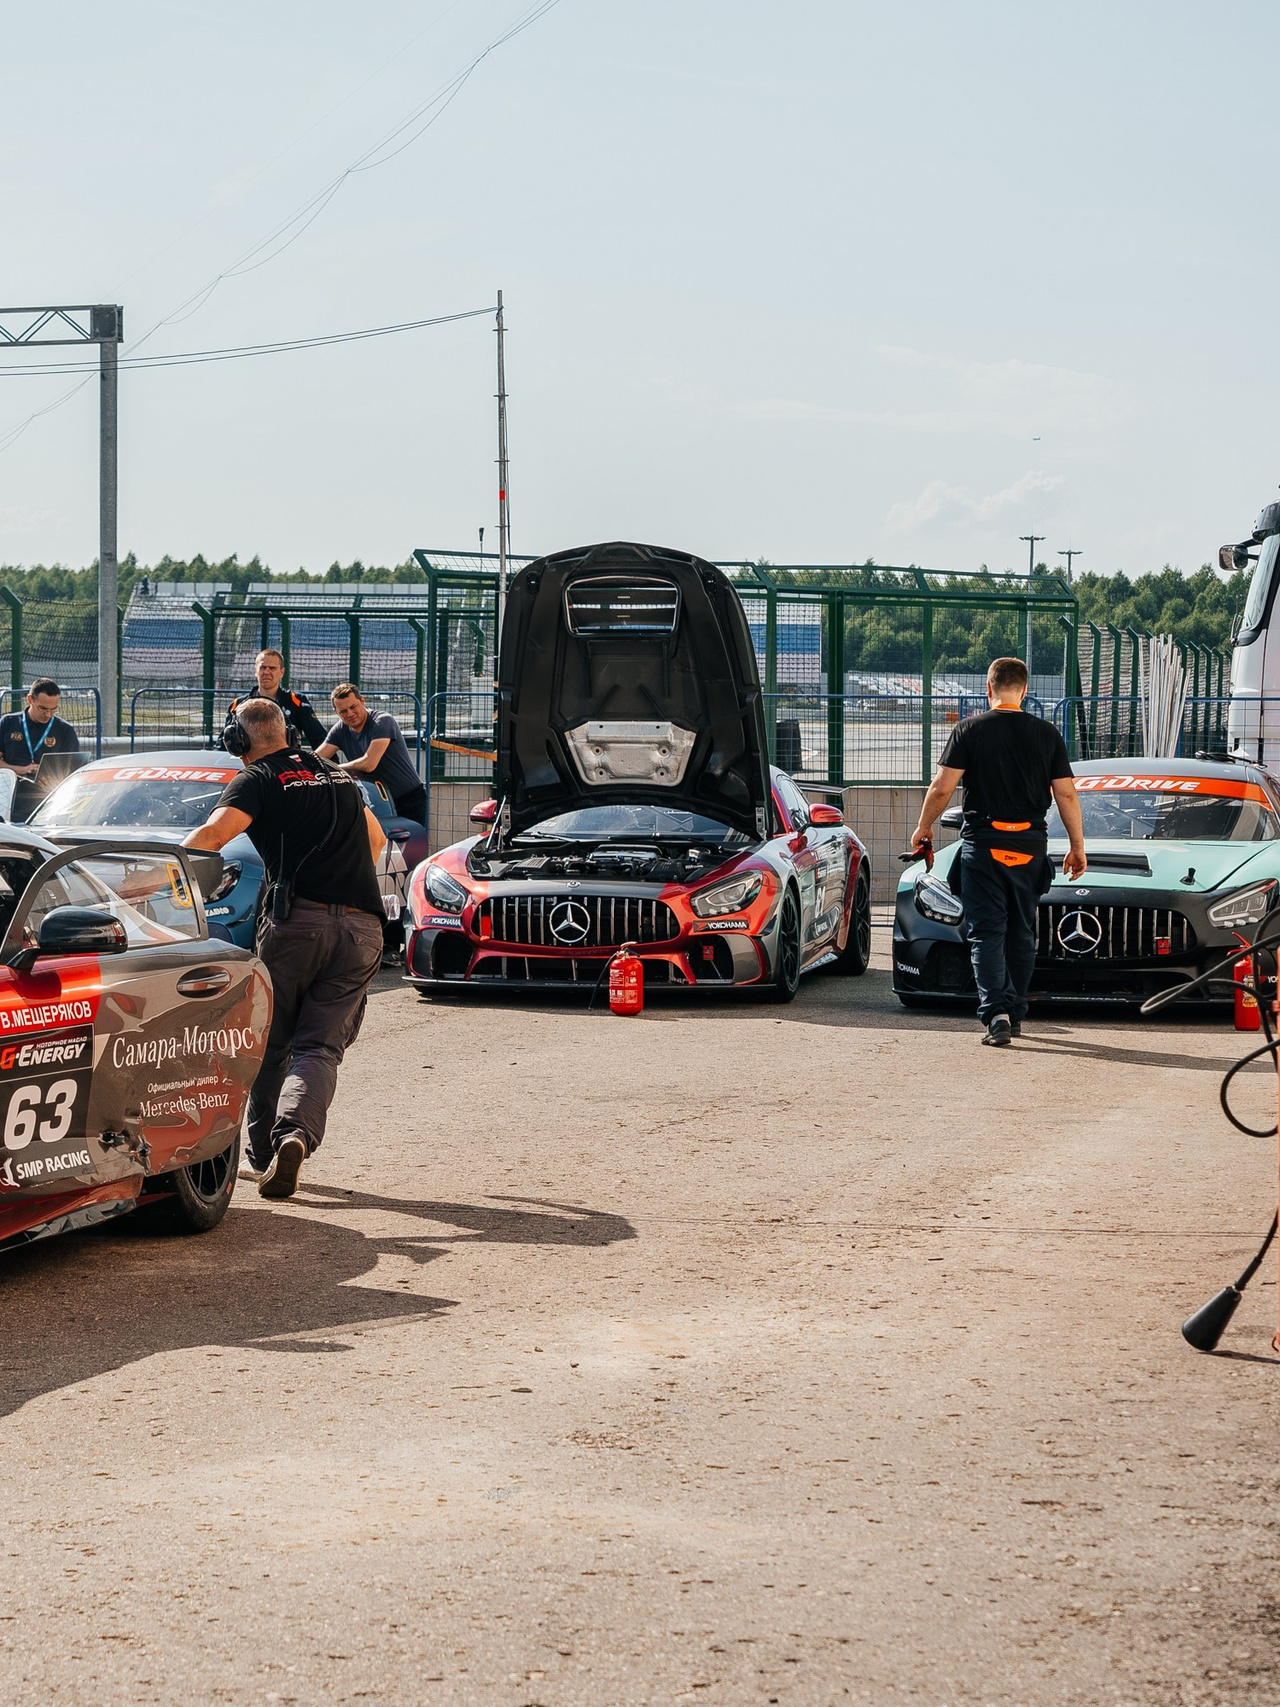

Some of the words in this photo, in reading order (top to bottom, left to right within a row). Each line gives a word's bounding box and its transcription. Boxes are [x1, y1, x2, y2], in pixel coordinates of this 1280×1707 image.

[431, 917, 461, 926] YOKOHAMA
[707, 921, 748, 930] YOKOHAMA
[0, 1000, 93, 1029] В.МЕЩЕРЯКОВ
[113, 1025, 254, 1069] Самара-Моторс
[196, 1075, 219, 1088] дилер
[4, 1078, 78, 1151] 63
[140, 1092, 230, 1118] Mercedes-Benz
[15, 1159, 44, 1180] SMP
[44, 1149, 91, 1173] RACING
